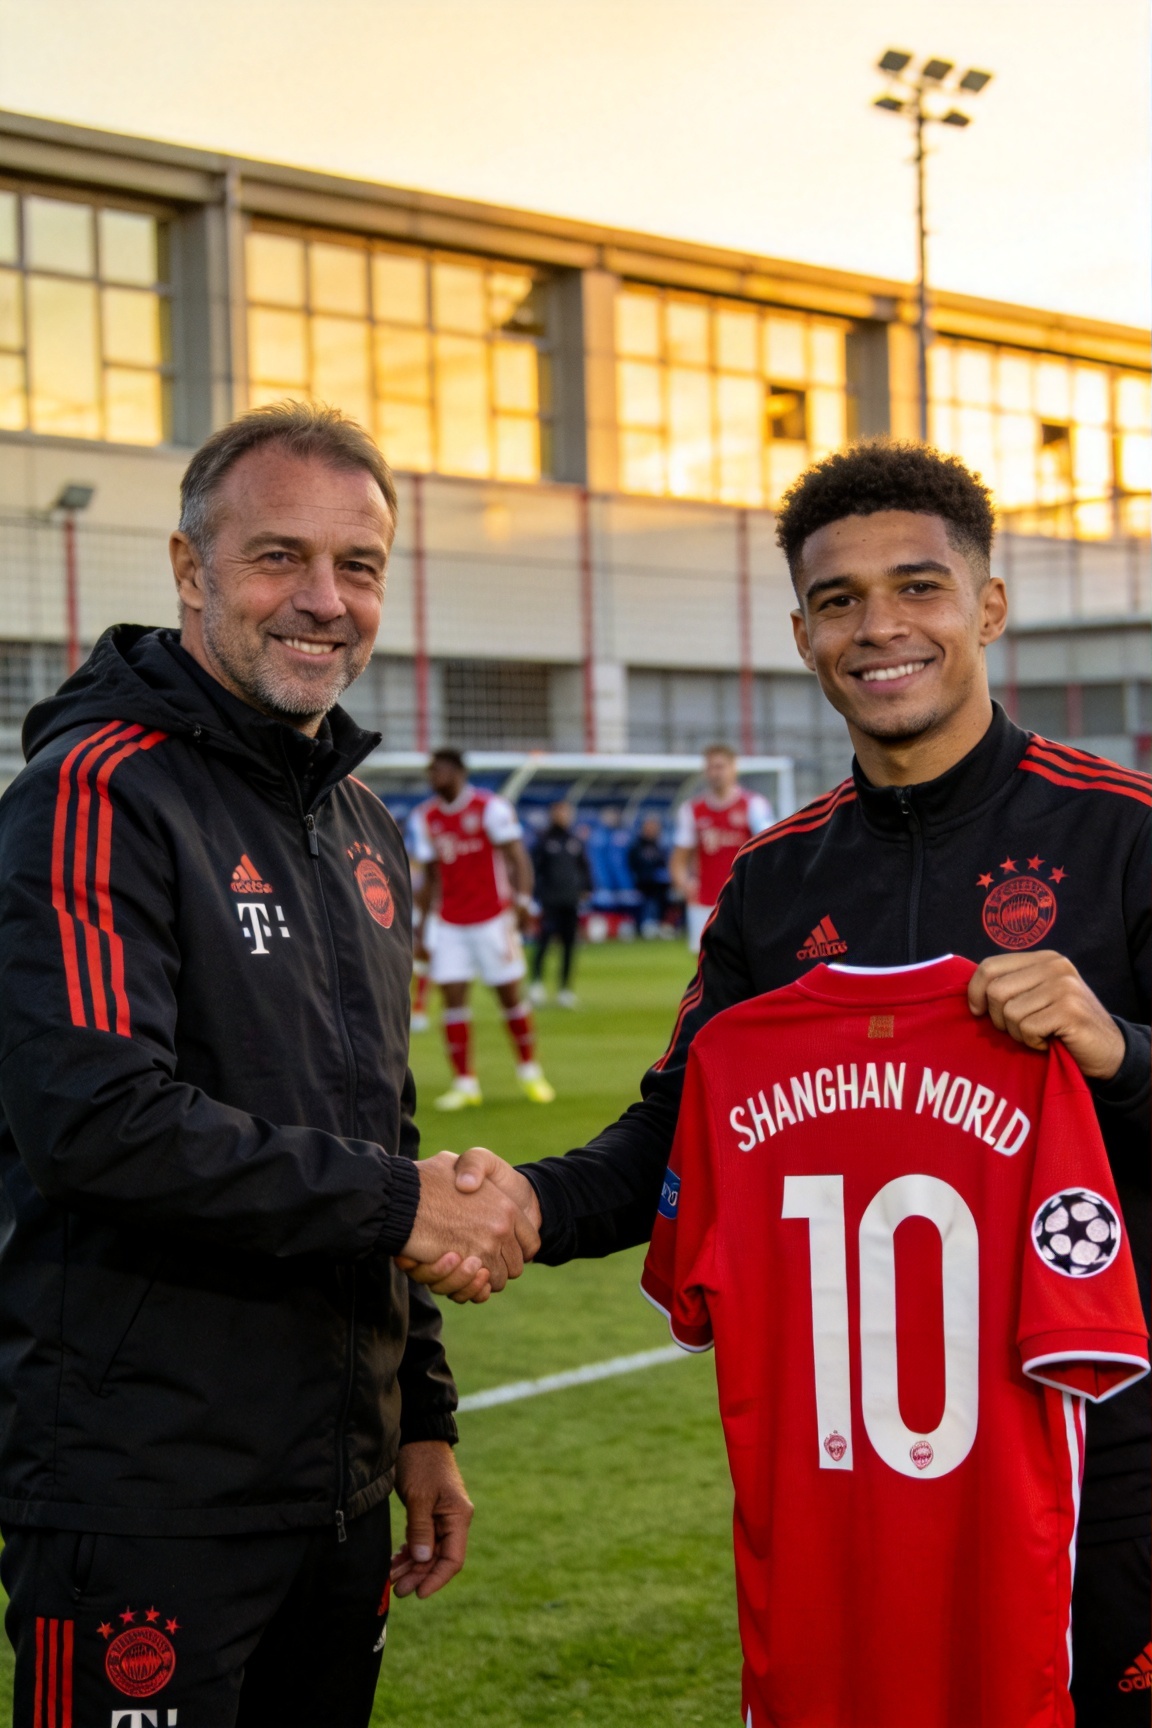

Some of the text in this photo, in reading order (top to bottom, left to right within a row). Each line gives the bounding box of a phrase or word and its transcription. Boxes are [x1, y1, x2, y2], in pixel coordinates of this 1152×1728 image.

[730, 1061, 1031, 1157] SHANGHAN MORLD
[780, 1173, 980, 1480] 10
